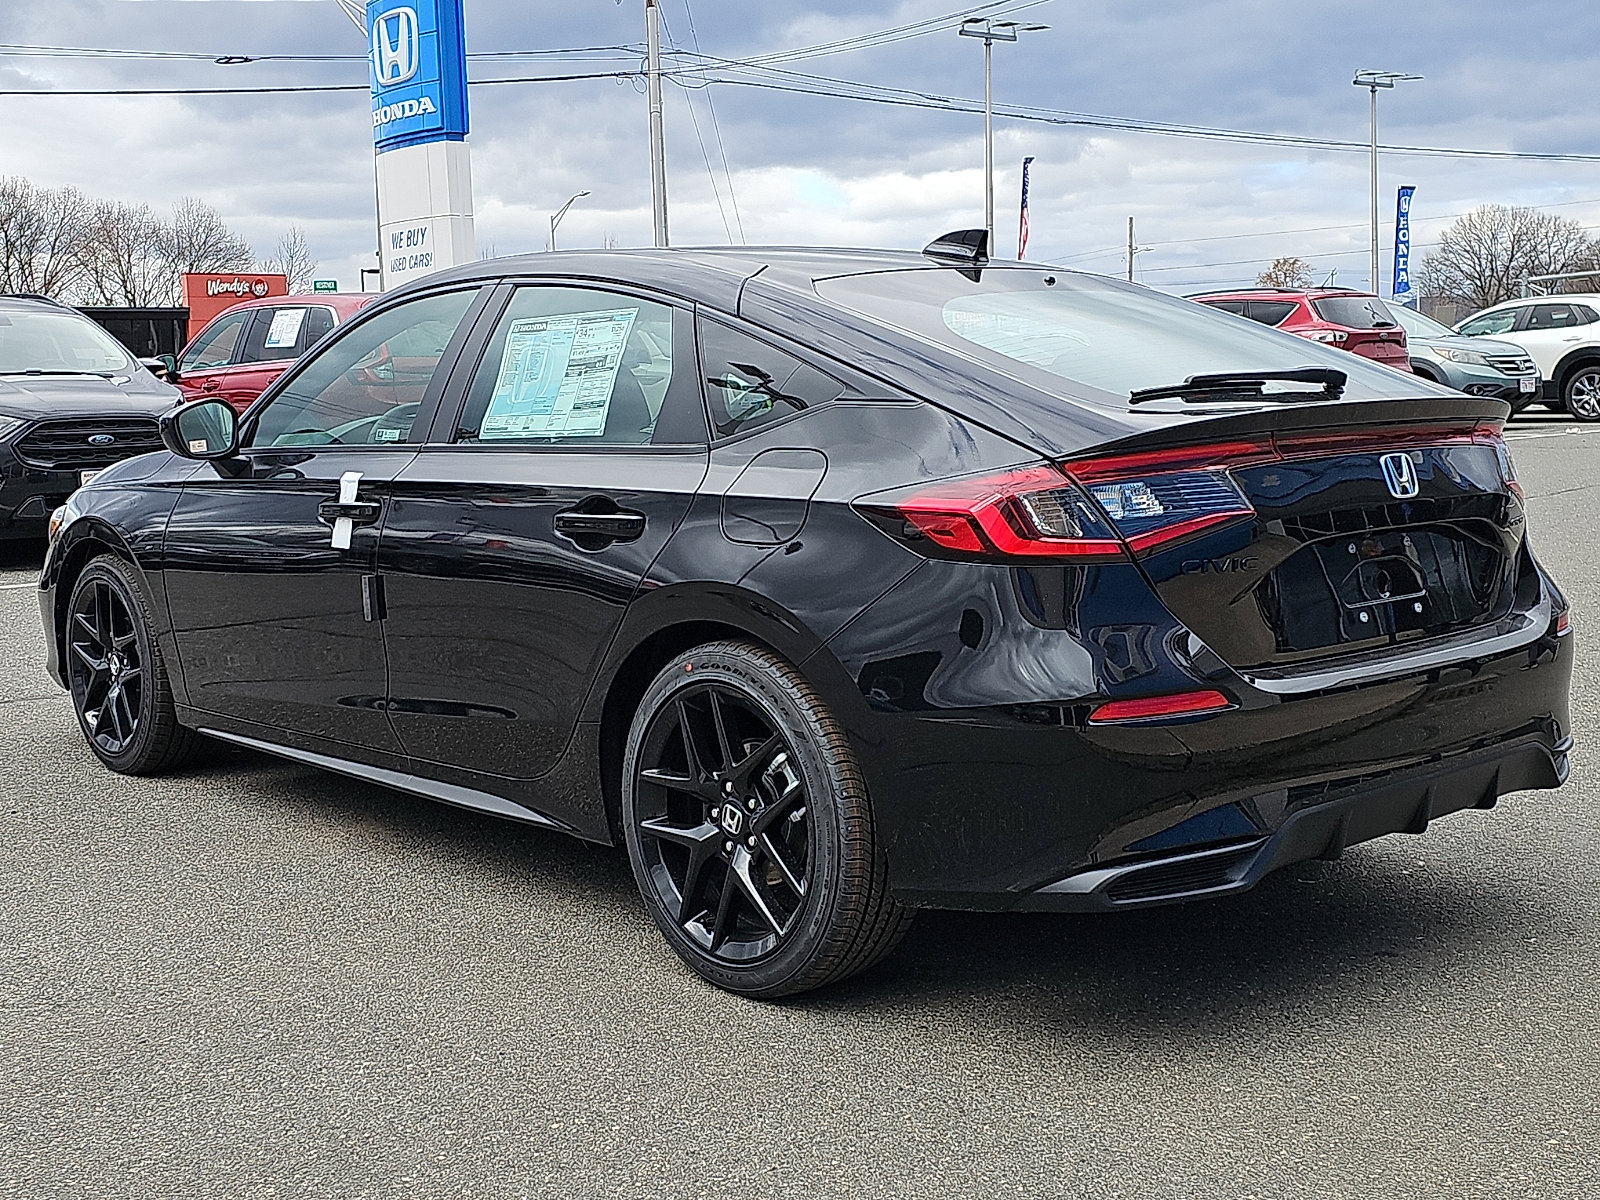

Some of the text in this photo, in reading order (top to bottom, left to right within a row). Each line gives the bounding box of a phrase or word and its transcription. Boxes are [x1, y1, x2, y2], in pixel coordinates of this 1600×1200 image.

[372, 96, 437, 128] HONDA
[391, 226, 428, 250] WE BUY
[390, 252, 433, 273] USED CARS!
[207, 277, 250, 297] Wendy's
[1180, 556, 1259, 575] CIVIC
[699, 662, 790, 717] GOODYEAR
